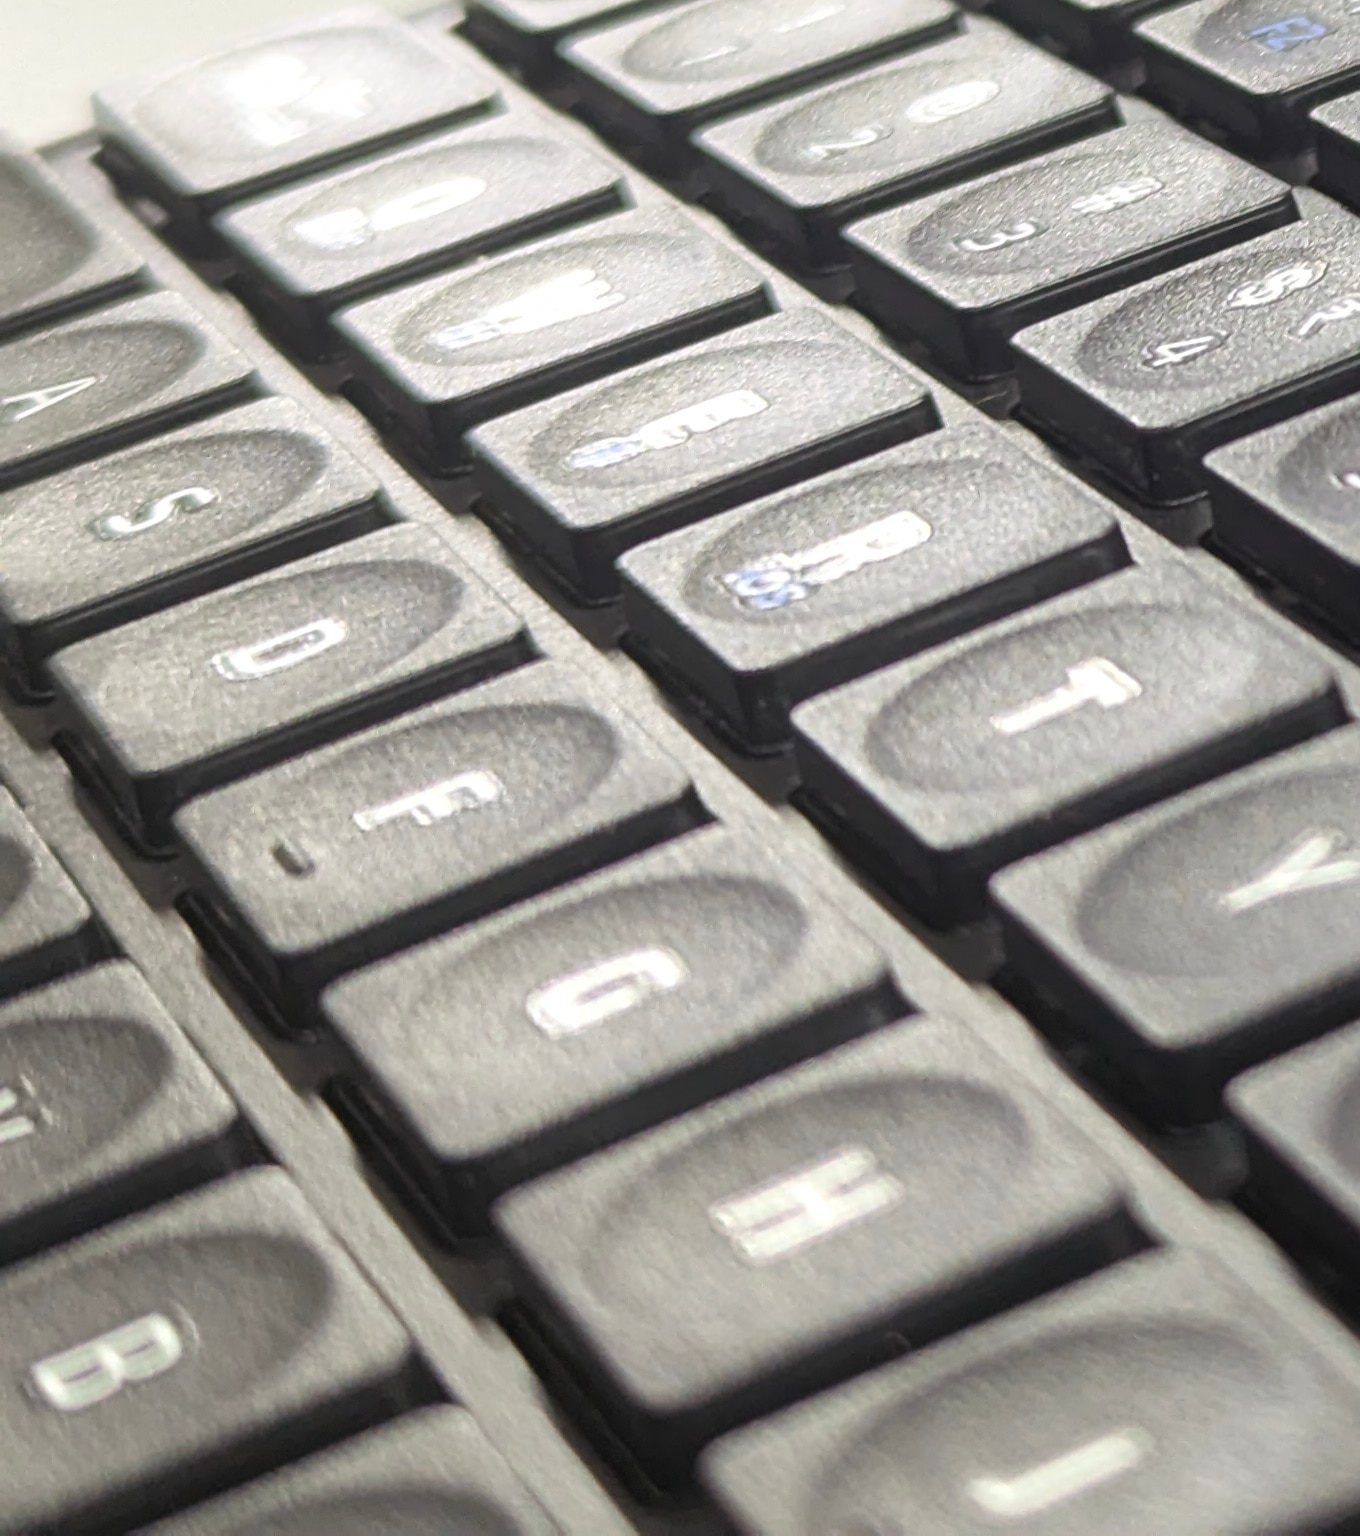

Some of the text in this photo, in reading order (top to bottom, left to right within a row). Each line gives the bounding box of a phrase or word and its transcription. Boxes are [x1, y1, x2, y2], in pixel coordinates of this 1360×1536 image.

[1, 375, 96, 421] A
[100, 485, 215, 536] S
[990, 656, 1142, 734] T
[352, 770, 502, 830] F
[708, 1146, 902, 1262] H
[28, 1312, 184, 1411] B
[966, 1427, 1155, 1518] J
